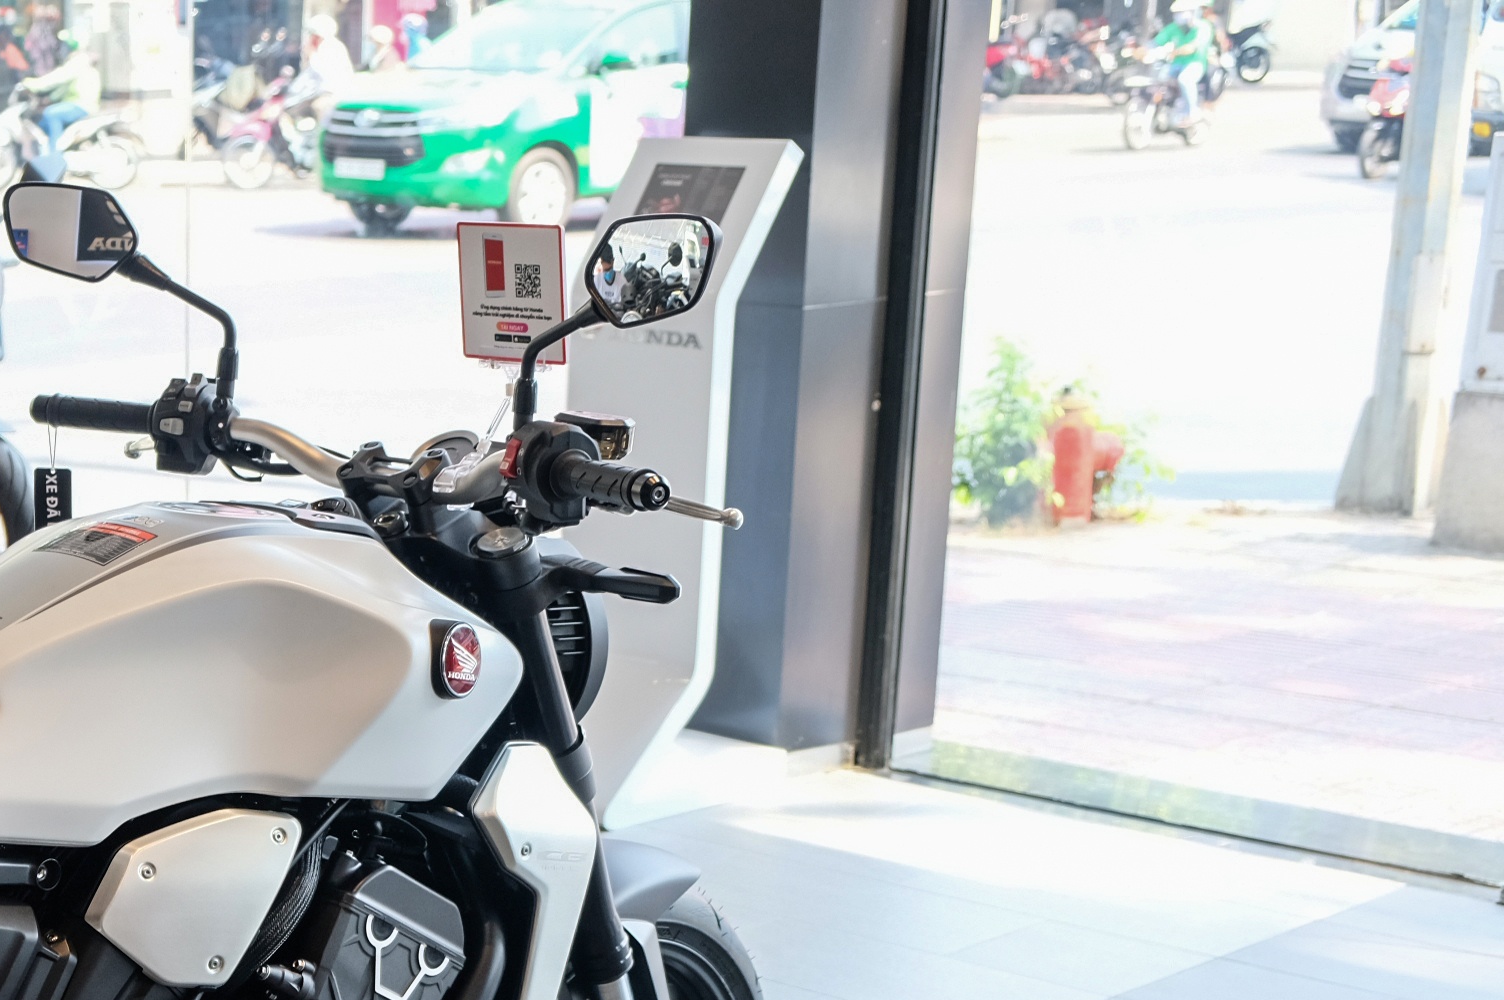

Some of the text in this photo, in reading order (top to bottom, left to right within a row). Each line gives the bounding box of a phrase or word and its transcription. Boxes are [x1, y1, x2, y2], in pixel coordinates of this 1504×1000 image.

[45, 474, 58, 493] XE
[46, 496, 61, 518] ĐÃ
[448, 671, 476, 681] HONDA
